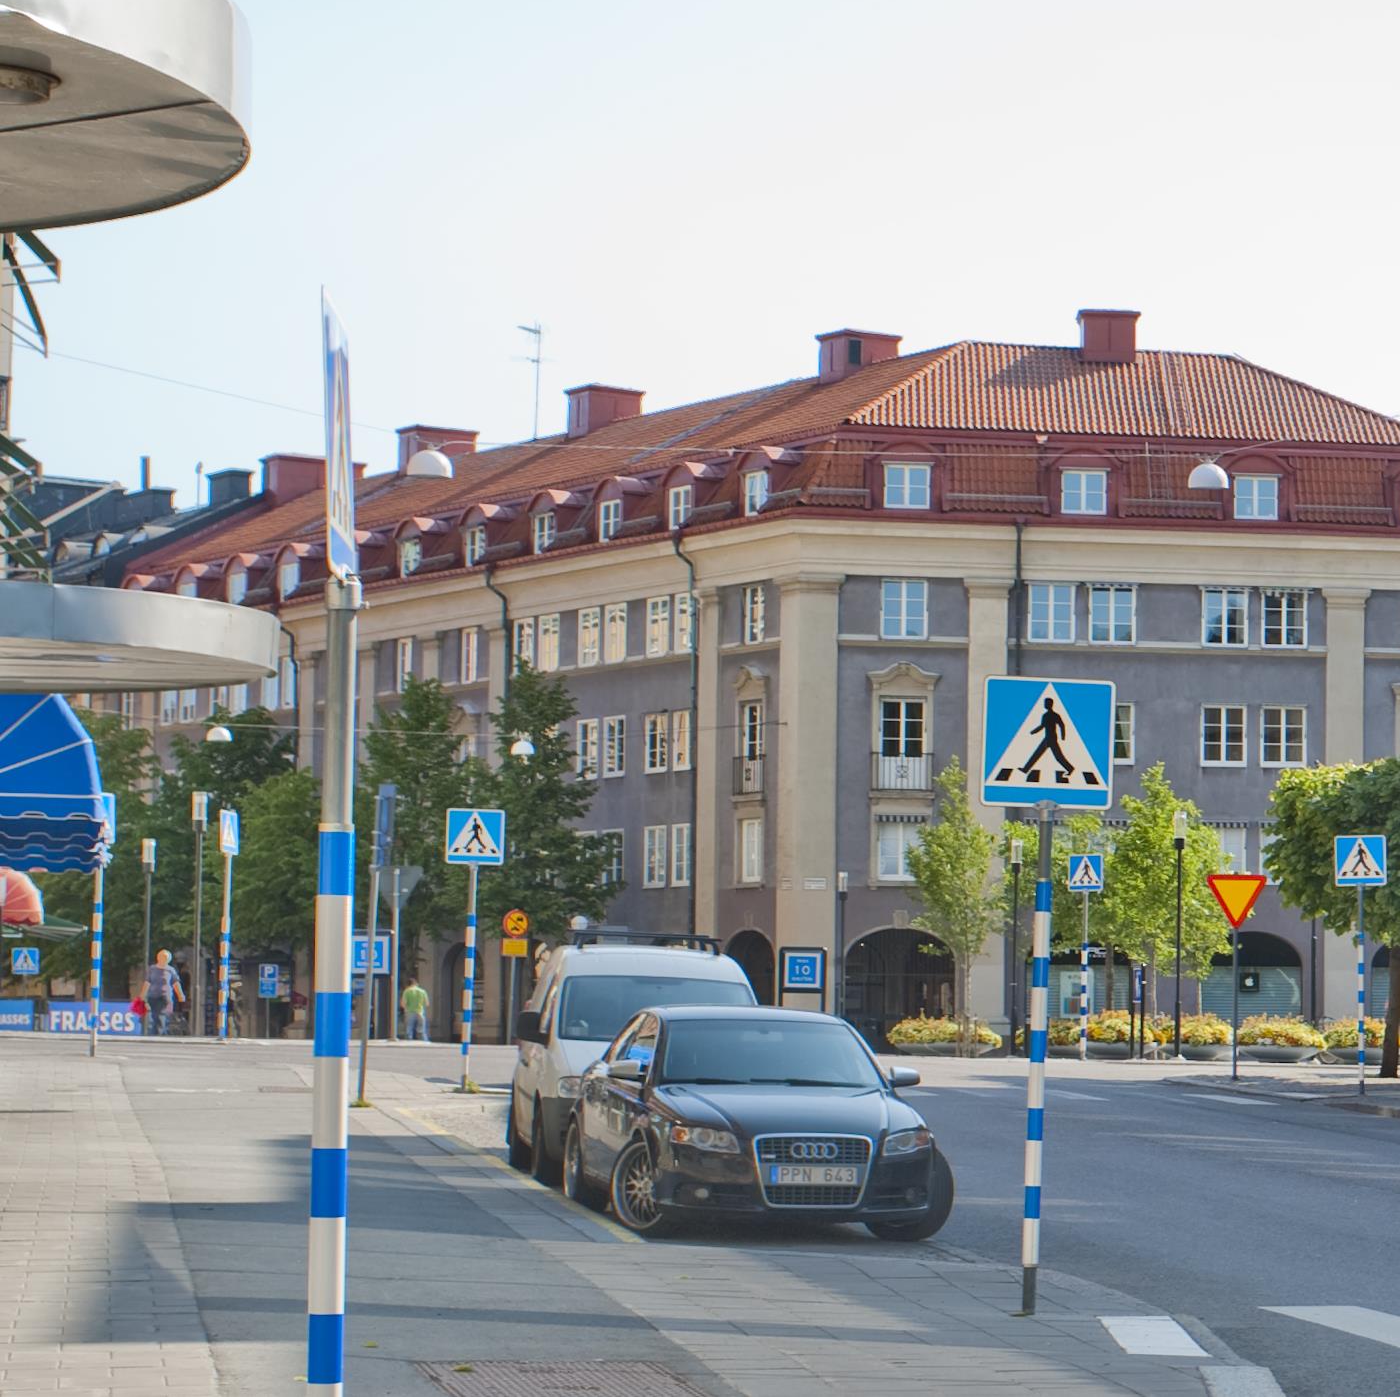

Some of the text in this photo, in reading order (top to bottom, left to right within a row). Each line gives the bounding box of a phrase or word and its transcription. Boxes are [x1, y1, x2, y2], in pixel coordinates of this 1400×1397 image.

[264, 966, 274, 978] P
[795, 965, 811, 975] 10
[780, 1168, 854, 1182] PPN 643
